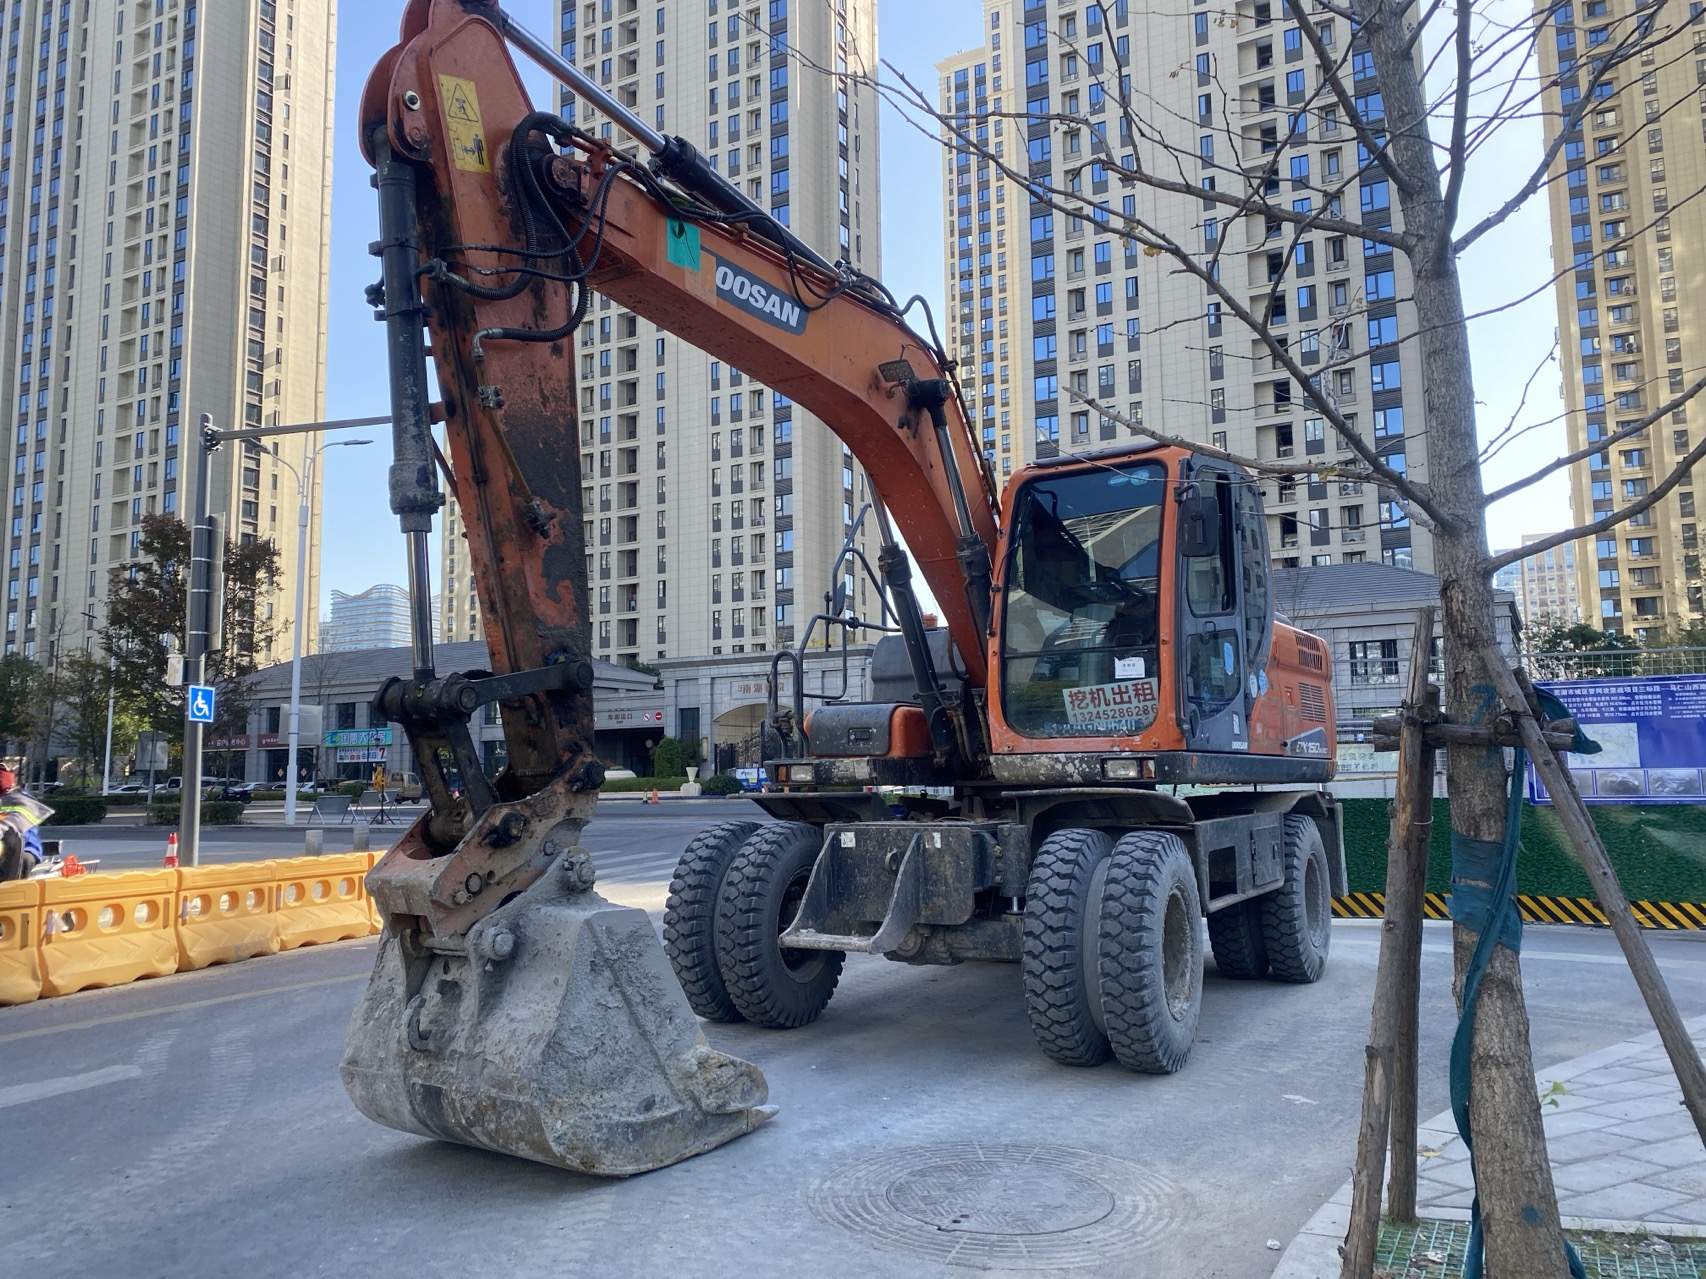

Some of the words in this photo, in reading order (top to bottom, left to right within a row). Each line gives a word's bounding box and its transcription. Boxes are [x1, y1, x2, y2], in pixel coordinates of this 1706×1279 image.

[1068, 681, 1157, 711] 挖机出租
[1073, 704, 1158, 723] 13245286286
